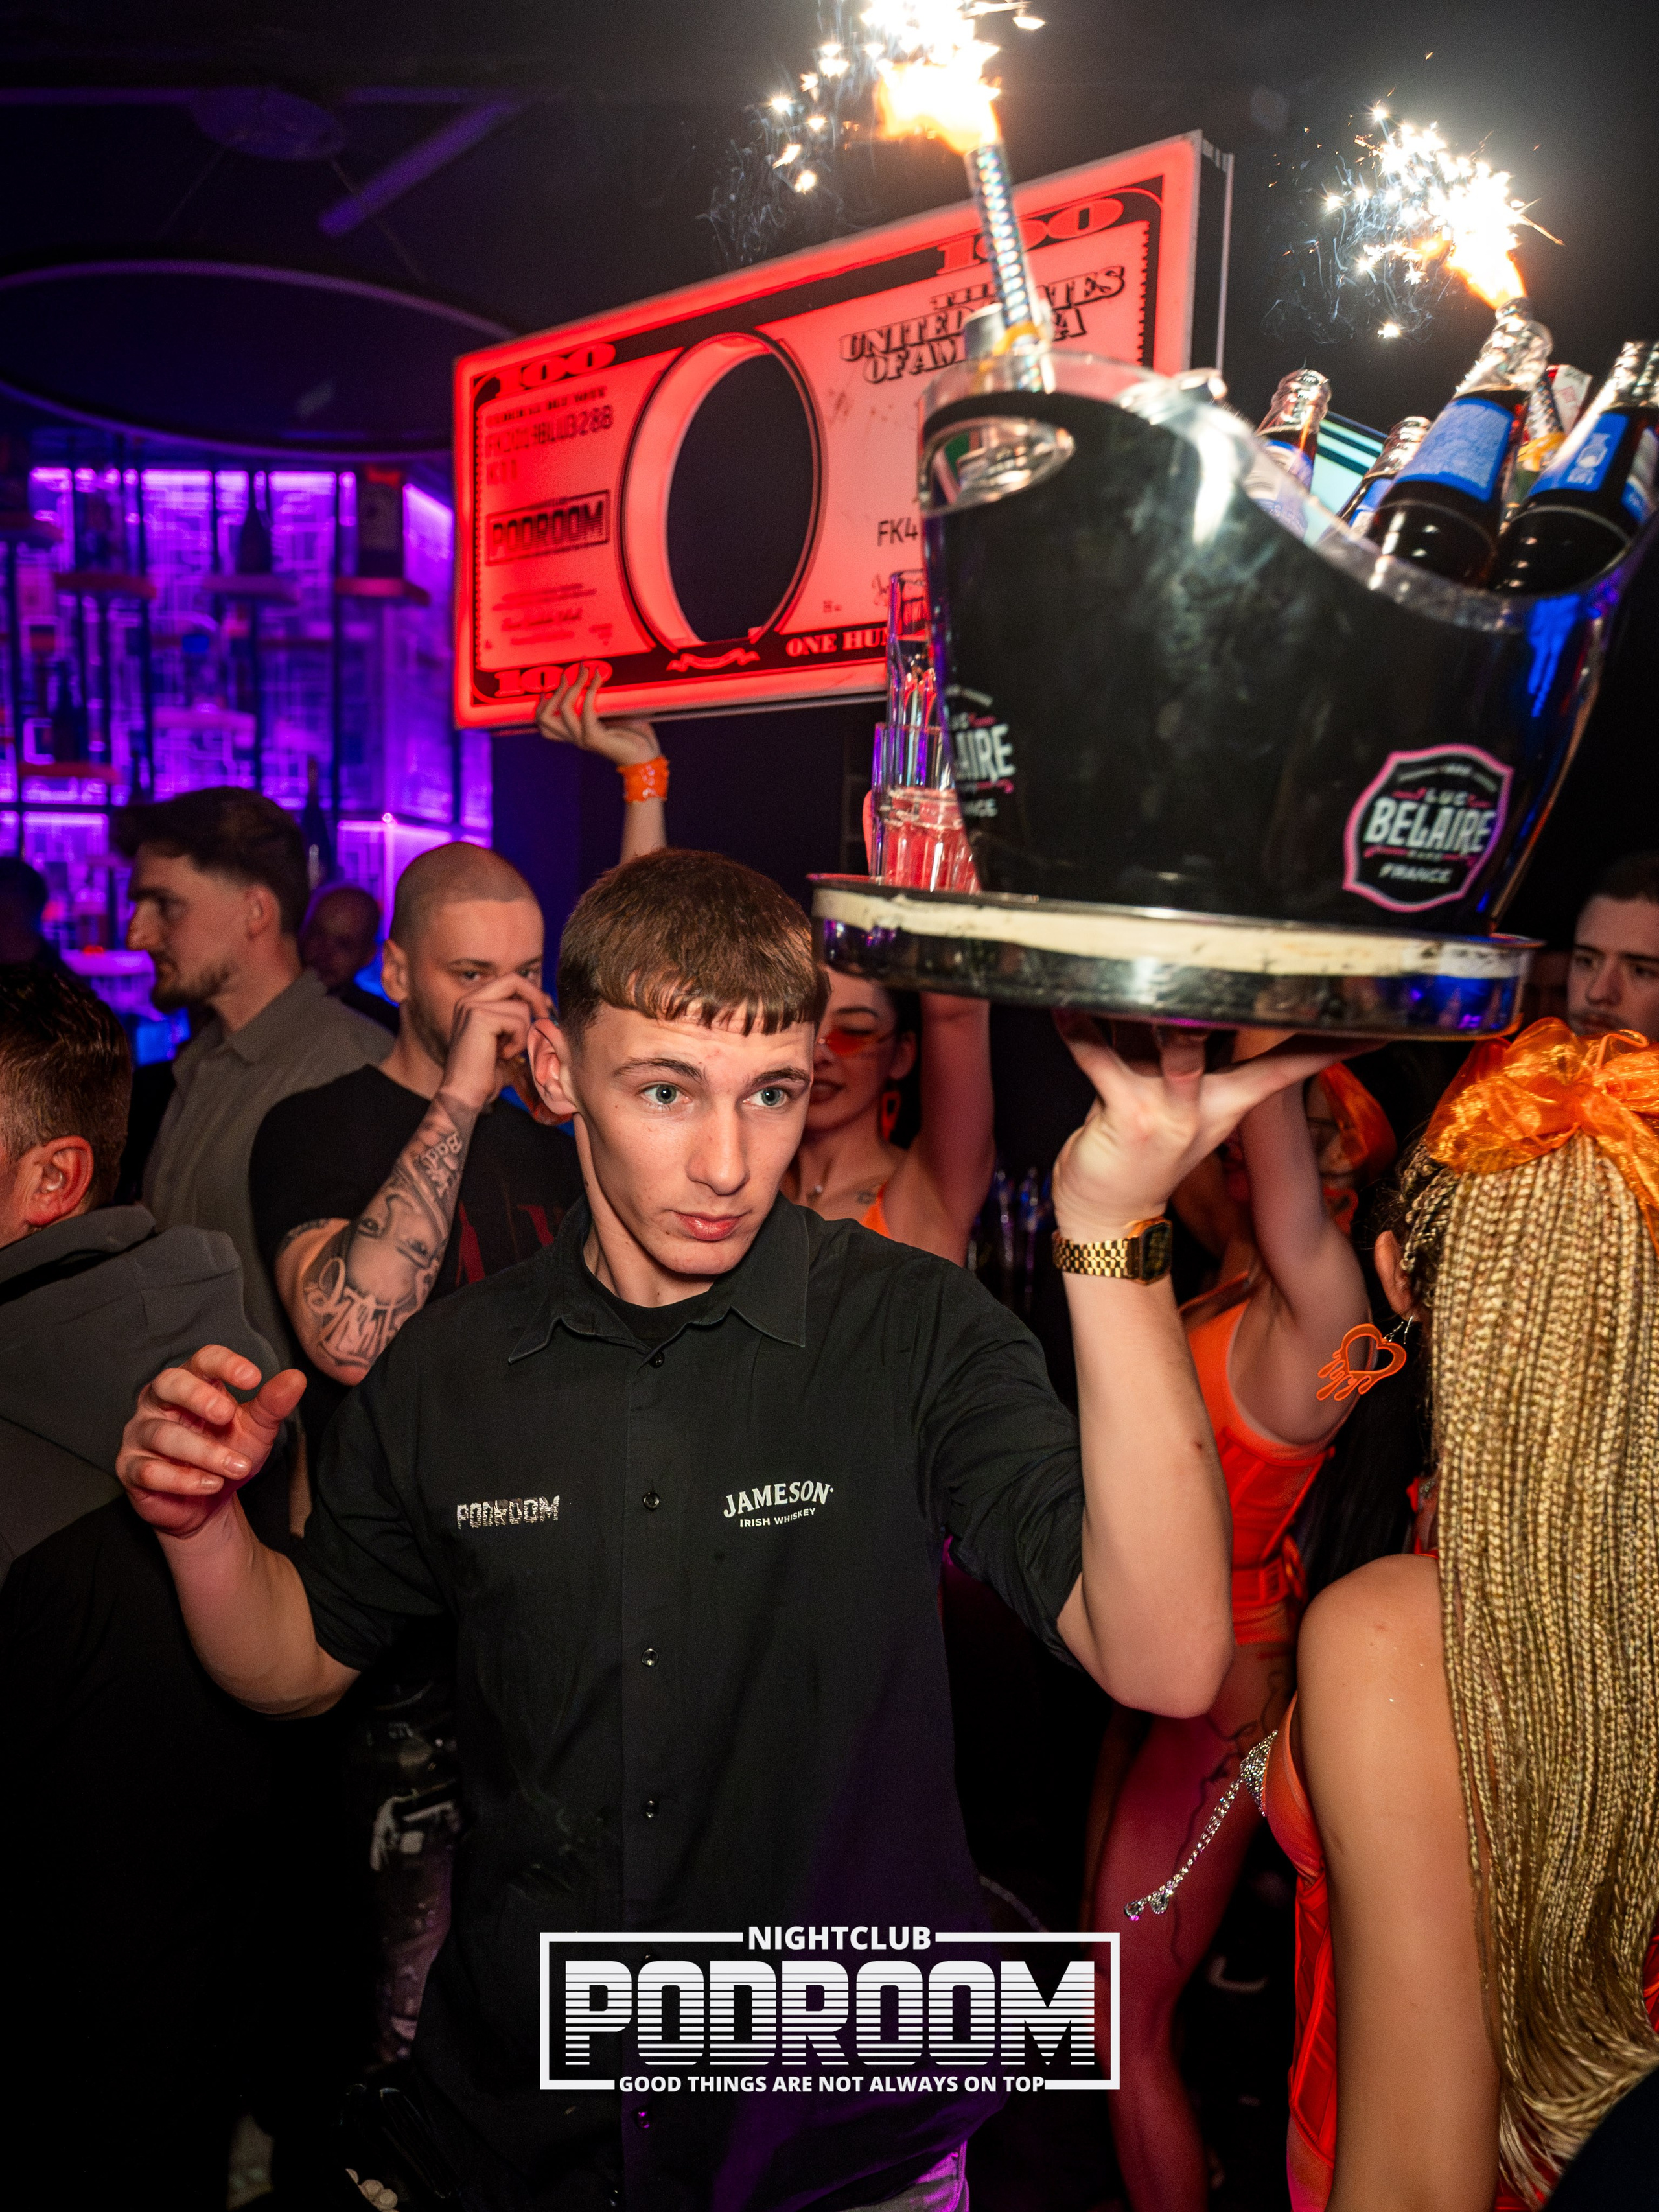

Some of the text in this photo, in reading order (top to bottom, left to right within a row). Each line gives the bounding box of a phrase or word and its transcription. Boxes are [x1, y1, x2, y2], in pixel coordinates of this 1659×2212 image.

[495, 343, 616, 399] 100
[493, 500, 604, 556] PODROOM
[785, 633, 837, 657] ONE
[1363, 797, 1496, 856] BELAIRE
[457, 1495, 560, 1529] PODROOM
[723, 1480, 831, 1517] JAMESON
[739, 1508, 816, 1528] IRISH WHISKEY
